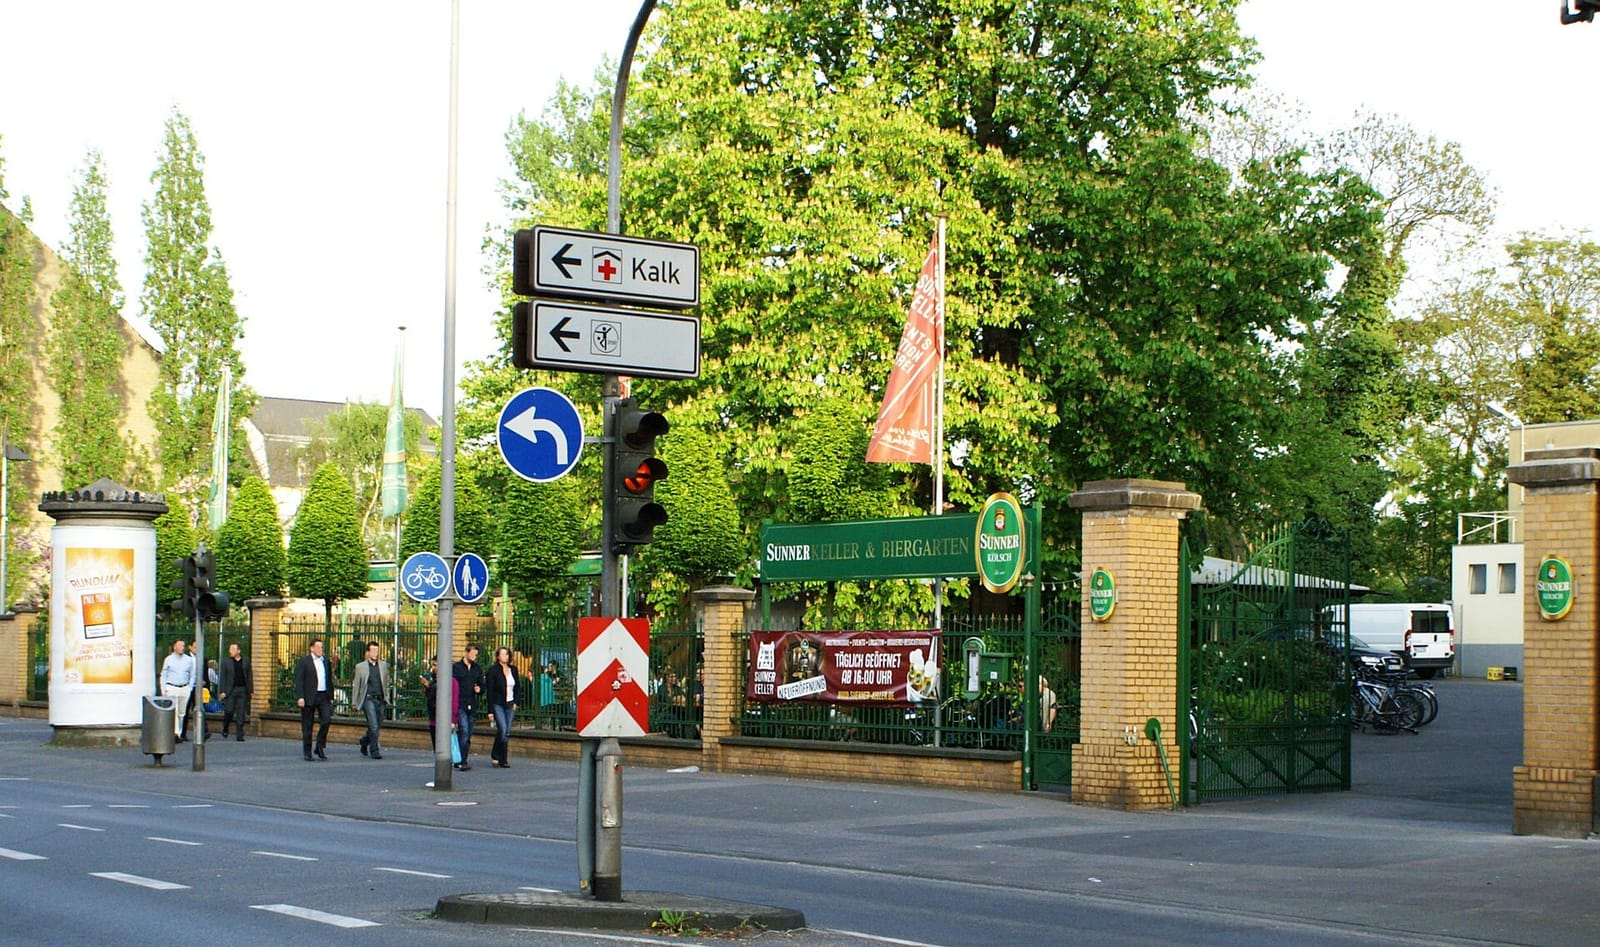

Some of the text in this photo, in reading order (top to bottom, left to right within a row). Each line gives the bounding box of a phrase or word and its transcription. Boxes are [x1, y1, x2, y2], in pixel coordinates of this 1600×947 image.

[632, 257, 680, 285] Kalk
[865, 541, 875, 559] &
[882, 537, 969, 558] BIERGARTEN
[834, 650, 902, 668] TÄGLICH GEÖFFNET
[841, 670, 893, 685] AB 16:00 UHR
